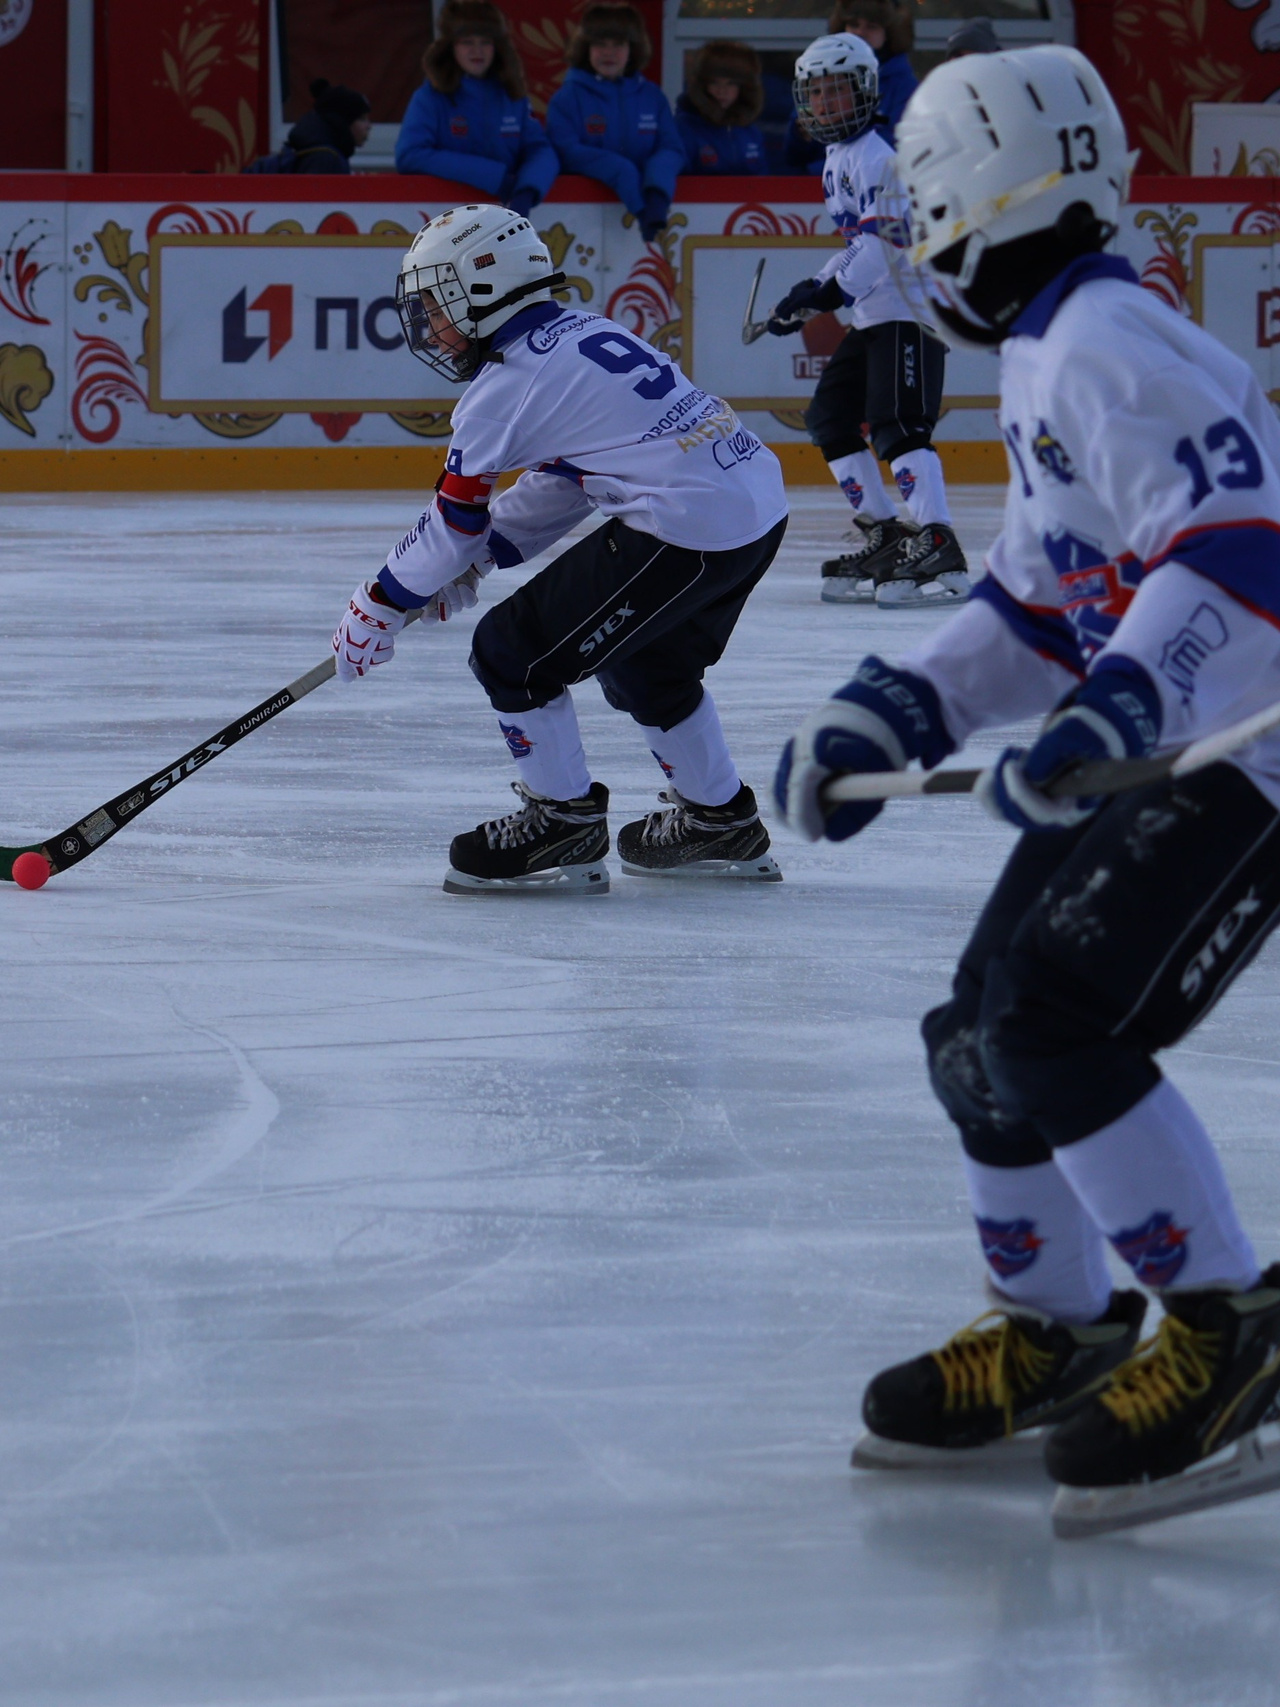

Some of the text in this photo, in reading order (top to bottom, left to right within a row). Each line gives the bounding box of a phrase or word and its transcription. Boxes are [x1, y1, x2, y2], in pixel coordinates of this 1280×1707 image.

[1058, 125, 1098, 174] 13
[451, 222, 482, 246] Reebok
[578, 331, 677, 400] 9
[903, 342, 916, 389] STEX
[1175, 417, 1264, 509] 13
[349, 600, 393, 631] STEX
[578, 600, 637, 658] STEX
[149, 694, 290, 797] STEX JUNIRAID
[558, 827, 600, 866] CCM
[1180, 884, 1262, 1002] STEX
